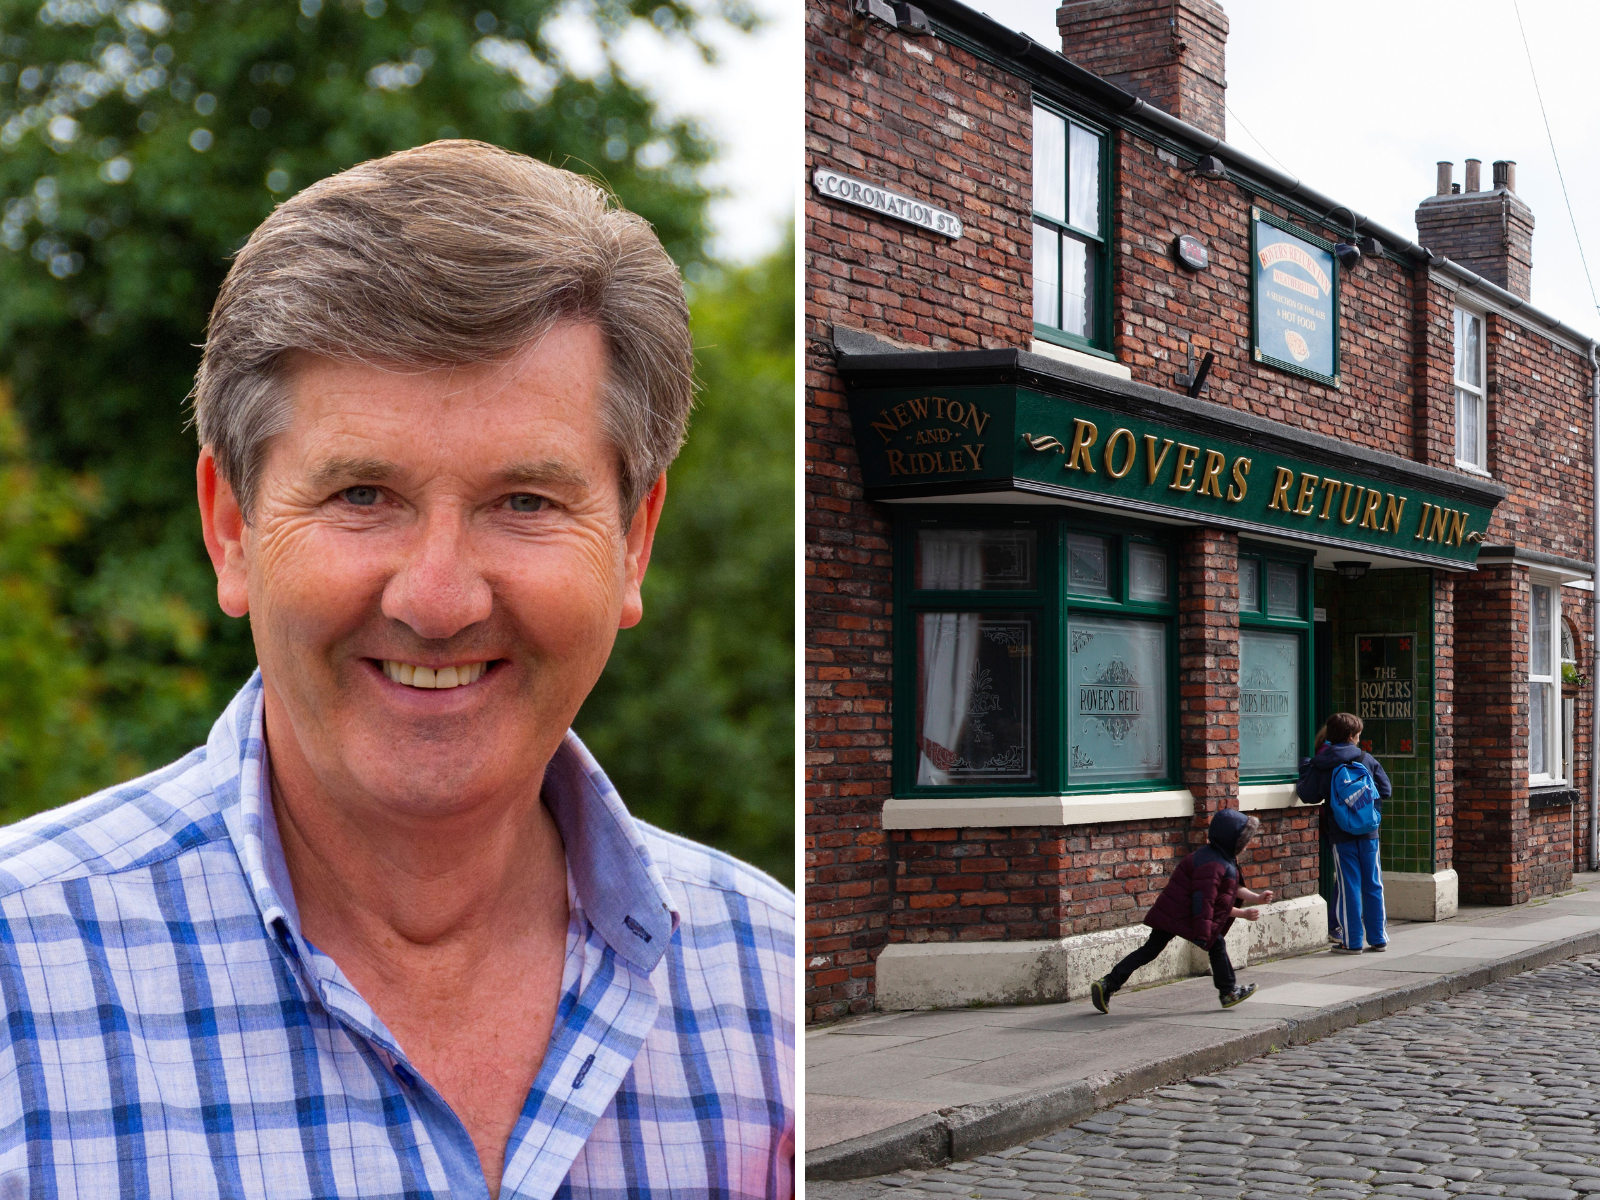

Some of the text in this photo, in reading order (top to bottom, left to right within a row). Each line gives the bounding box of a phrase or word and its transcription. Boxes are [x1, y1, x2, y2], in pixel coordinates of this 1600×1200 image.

[827, 175, 933, 227] CORONATION
[1260, 244, 1330, 293] ROVERS RETURN INN
[1274, 270, 1318, 298] WEATHERFIELD
[1266, 290, 1326, 320] A SELECTION OF FINE ALES
[1281, 309, 1296, 323] HOT
[1297, 315, 1316, 331] FOOD
[870, 396, 991, 445] NEWTON
[915, 428, 951, 445] AND
[885, 443, 985, 476] RIDLEY
[1064, 417, 1469, 547] ROVERS RETURN INN
[1374, 666, 1397, 679] THE
[1080, 688, 1116, 711] ROVERS
[1360, 681, 1411, 699] ROVERS
[1239, 693, 1289, 713] VERS RETURN
[1360, 700, 1411, 718] RETURN
